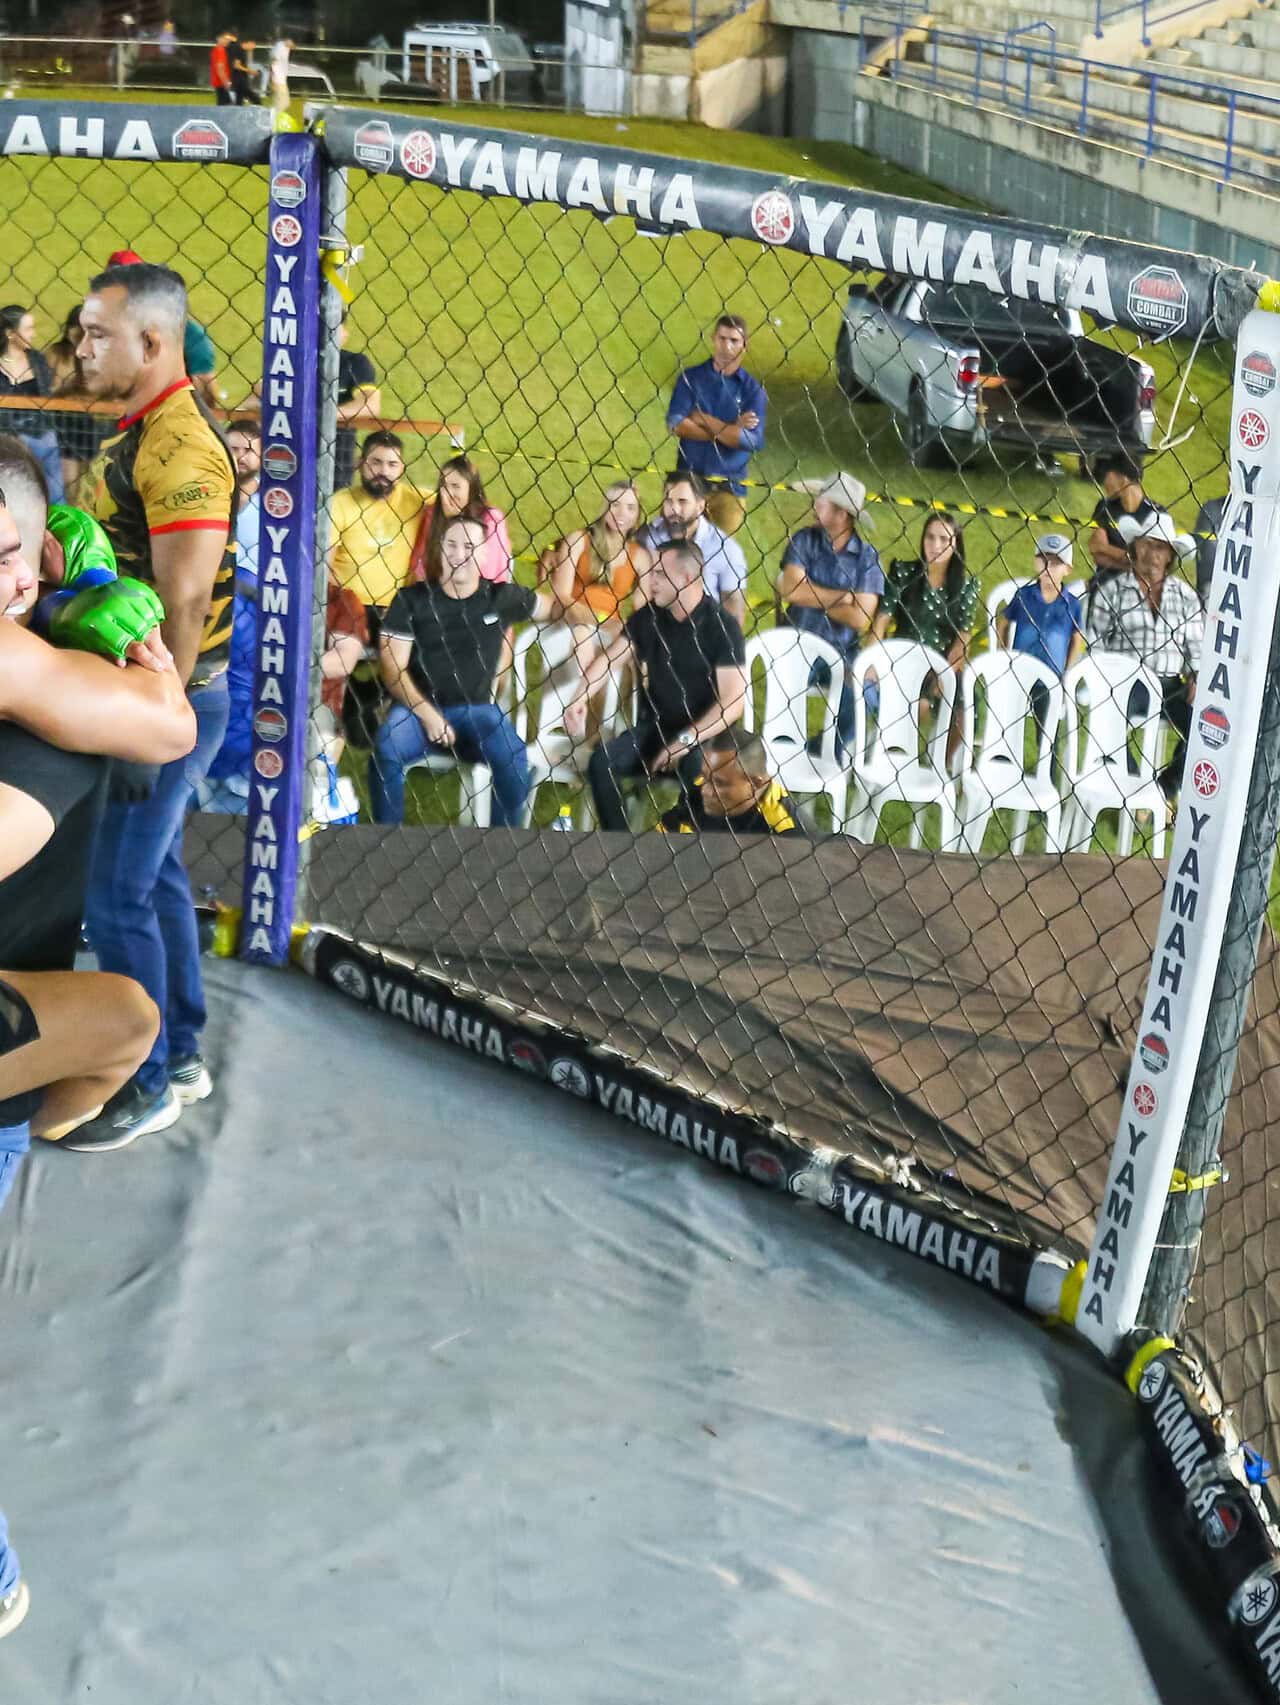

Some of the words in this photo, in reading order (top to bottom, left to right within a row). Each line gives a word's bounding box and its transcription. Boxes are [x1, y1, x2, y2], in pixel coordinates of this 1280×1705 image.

[439, 133, 701, 229] YAMAHA
[799, 195, 1118, 322] YAMAHA
[1136, 300, 1177, 320] COMBAT
[270, 254, 298, 439] YAMAHA
[260, 526, 290, 704] YAMAHA
[1208, 459, 1262, 700] YAMAHA
[249, 785, 278, 954] YAMAHA
[1151, 806, 1210, 1032] YAMAHA
[372, 976, 506, 1062] YAMAHA
[594, 1075, 742, 1173] YAMAHA
[842, 1184, 1001, 1290] YAMAHA
[1085, 1122, 1148, 1325] YAMAHA
